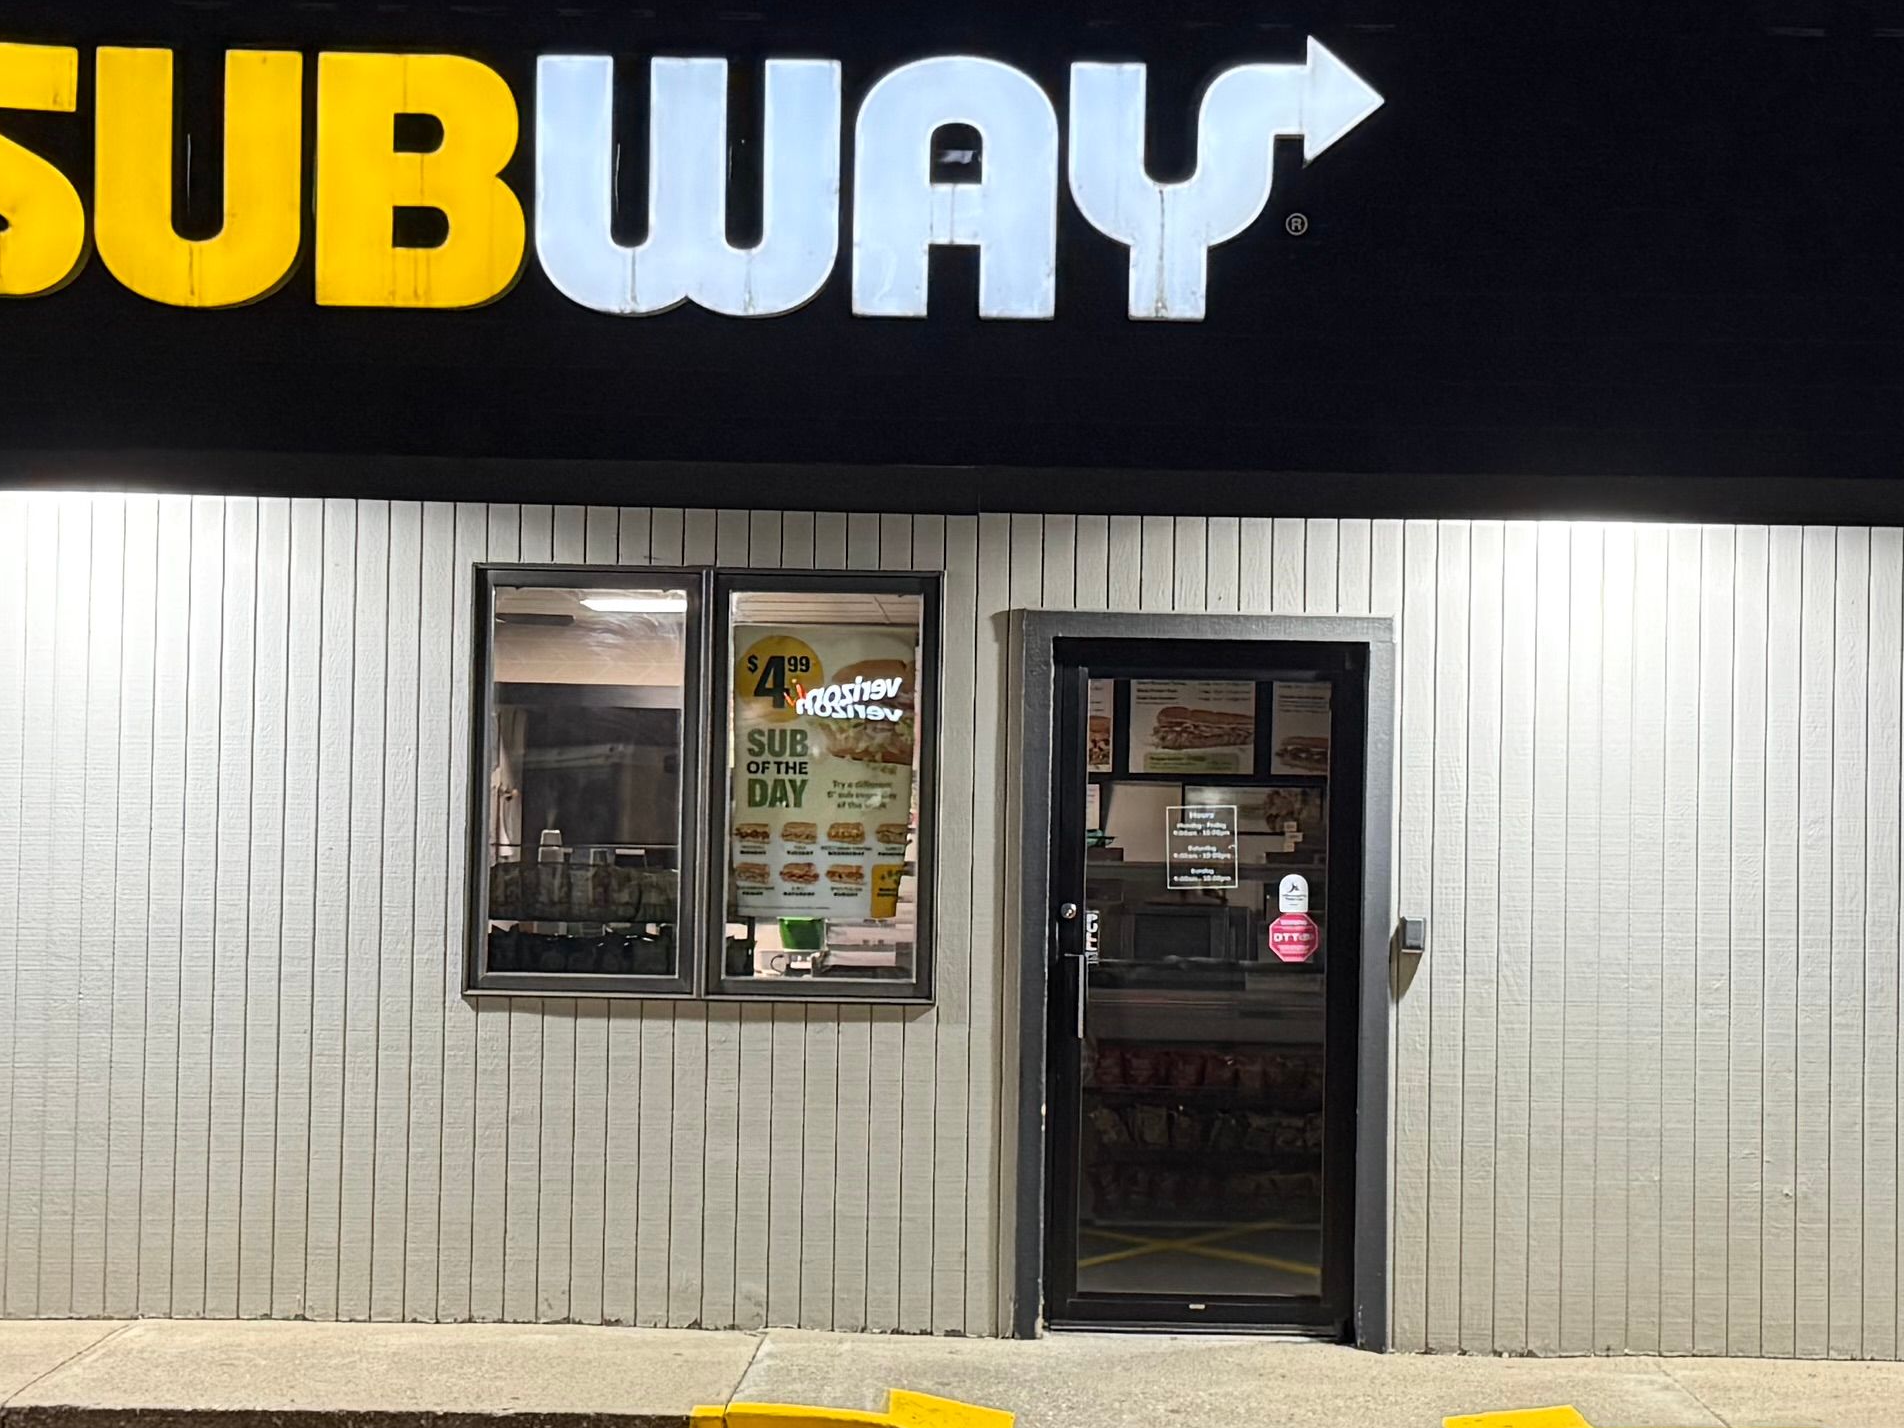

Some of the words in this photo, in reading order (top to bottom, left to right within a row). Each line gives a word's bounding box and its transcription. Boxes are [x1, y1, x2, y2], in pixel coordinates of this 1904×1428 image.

[747, 728, 809, 758] SUB
[747, 761, 771, 775] OF
[773, 761, 809, 775] THE
[747, 778, 809, 808] DAY
